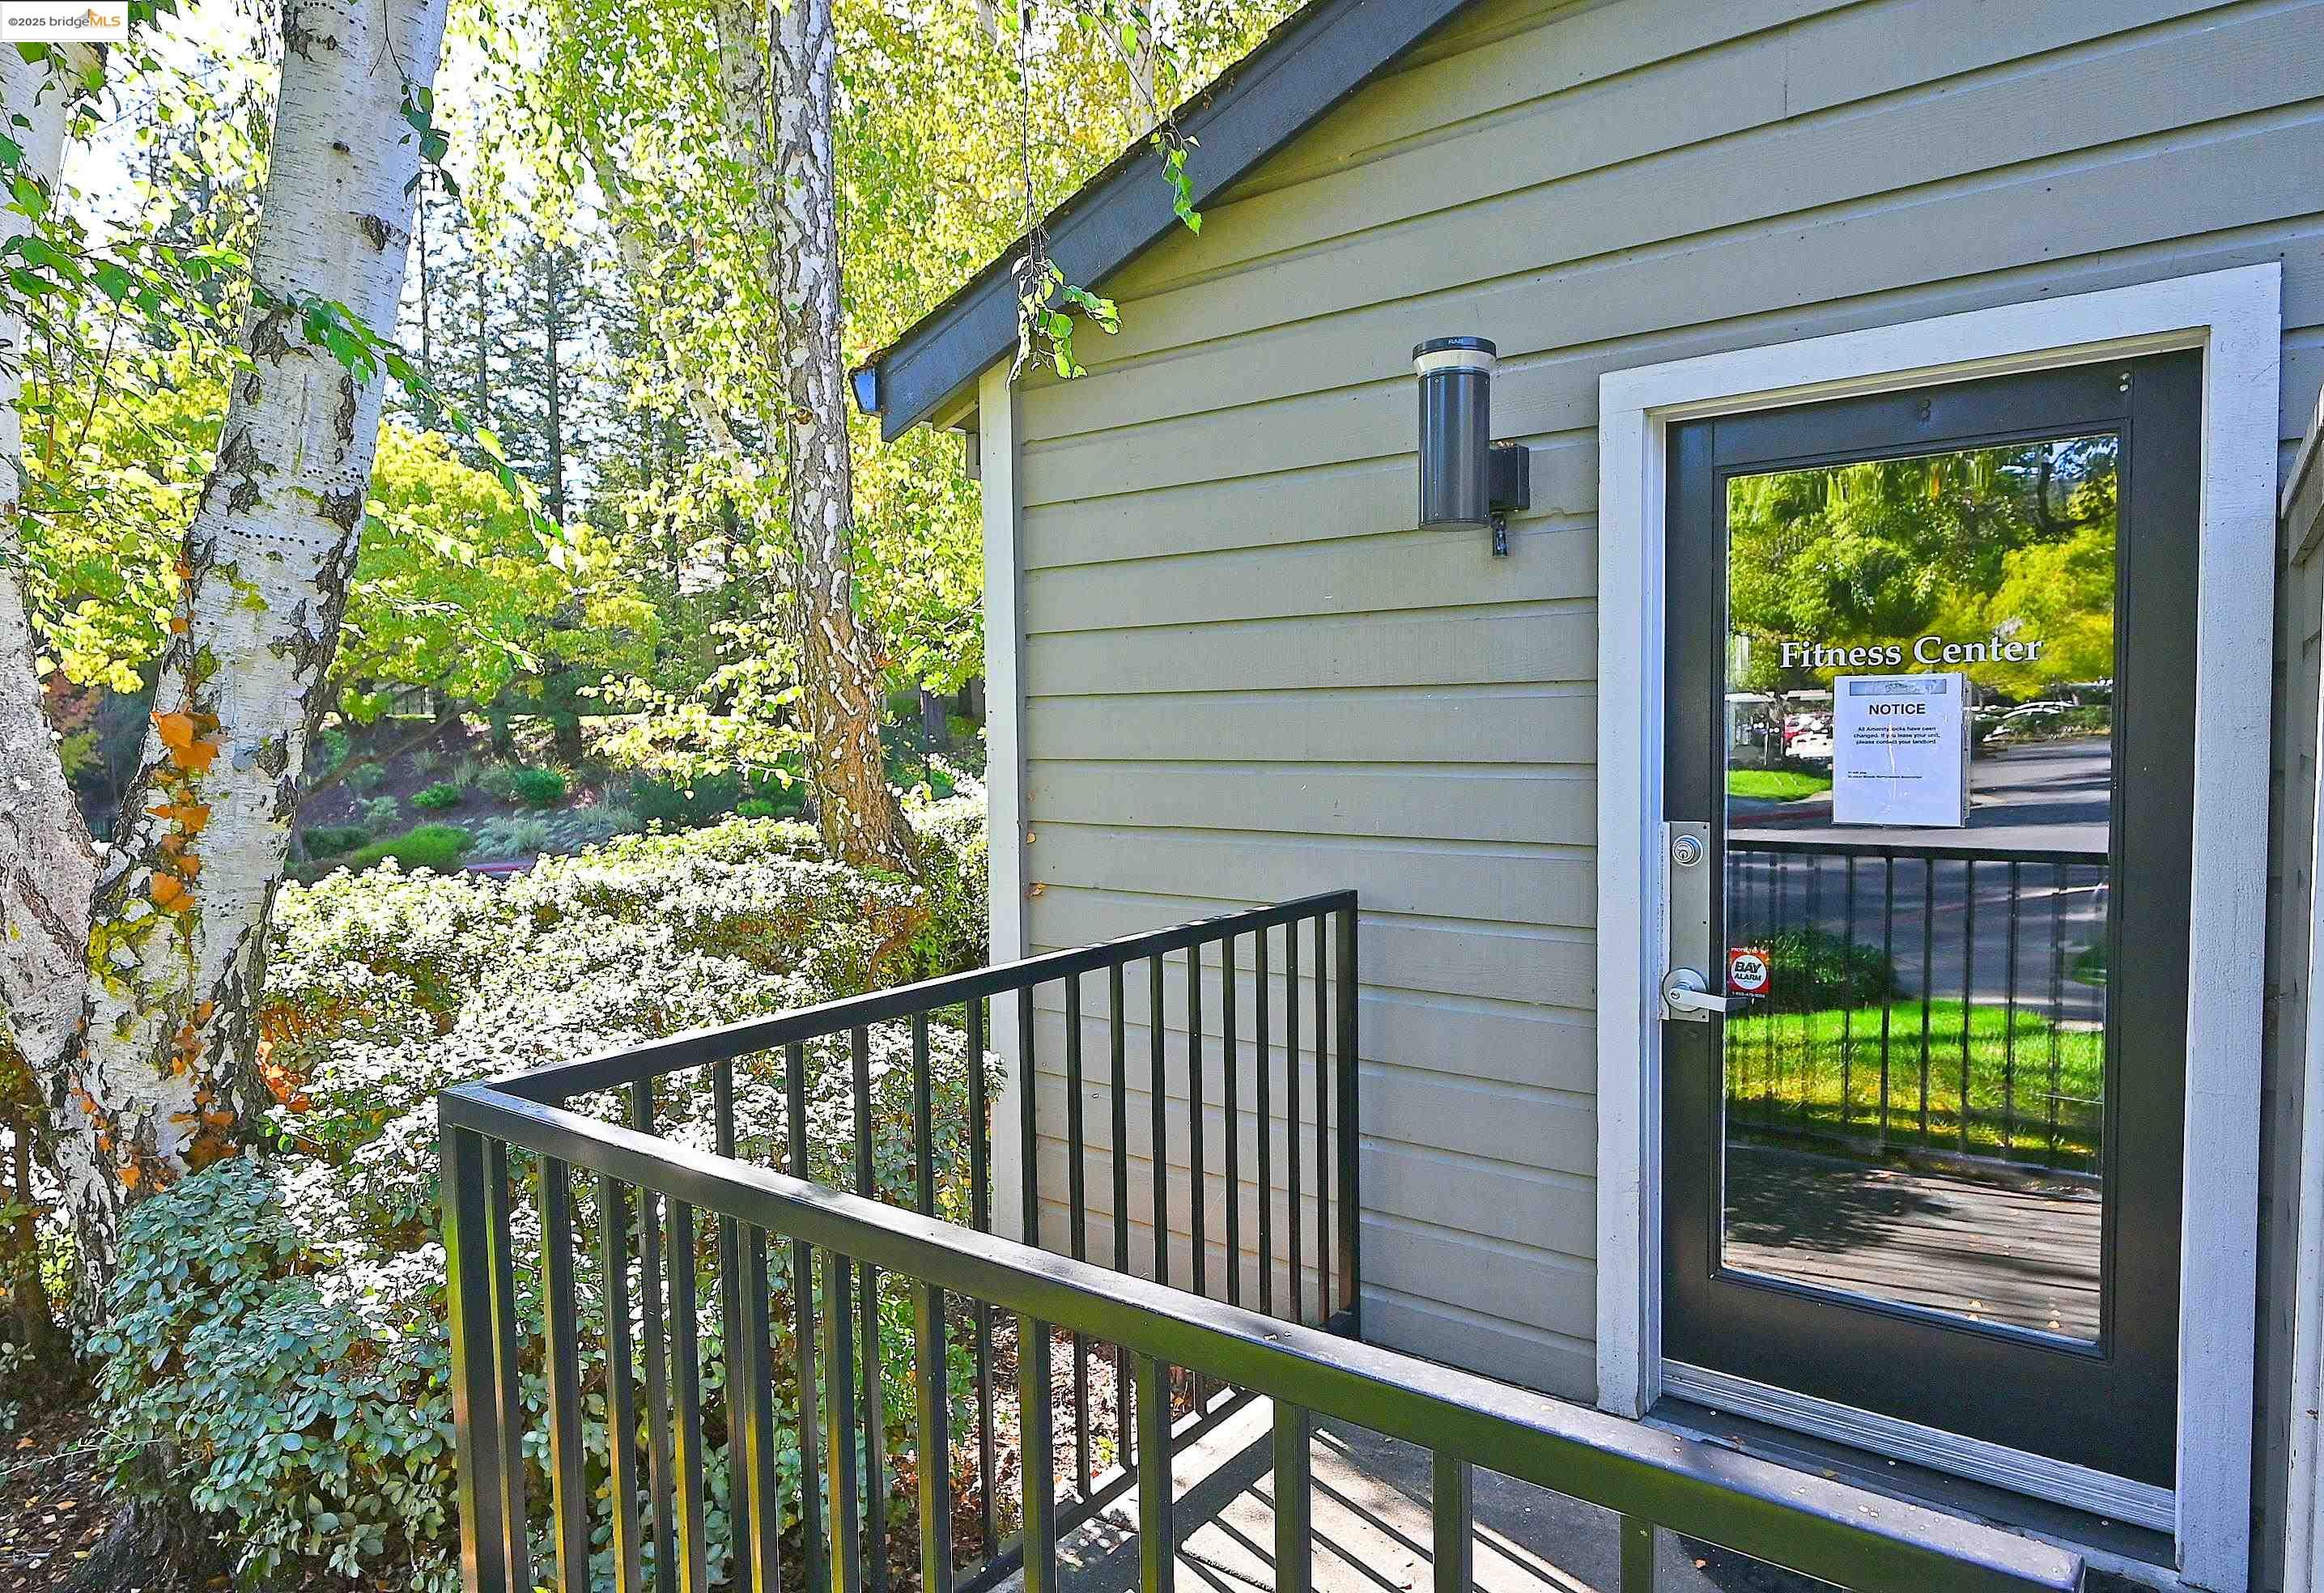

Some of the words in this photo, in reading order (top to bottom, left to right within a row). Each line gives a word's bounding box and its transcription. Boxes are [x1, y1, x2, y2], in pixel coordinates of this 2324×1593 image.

[1780, 640, 1901, 668] Fitness
[1913, 636, 2044, 665] Center
[1868, 703, 1926, 715] NOTICE
[1735, 962, 1762, 974] BAY
[1735, 973, 1762, 981] ALARM
